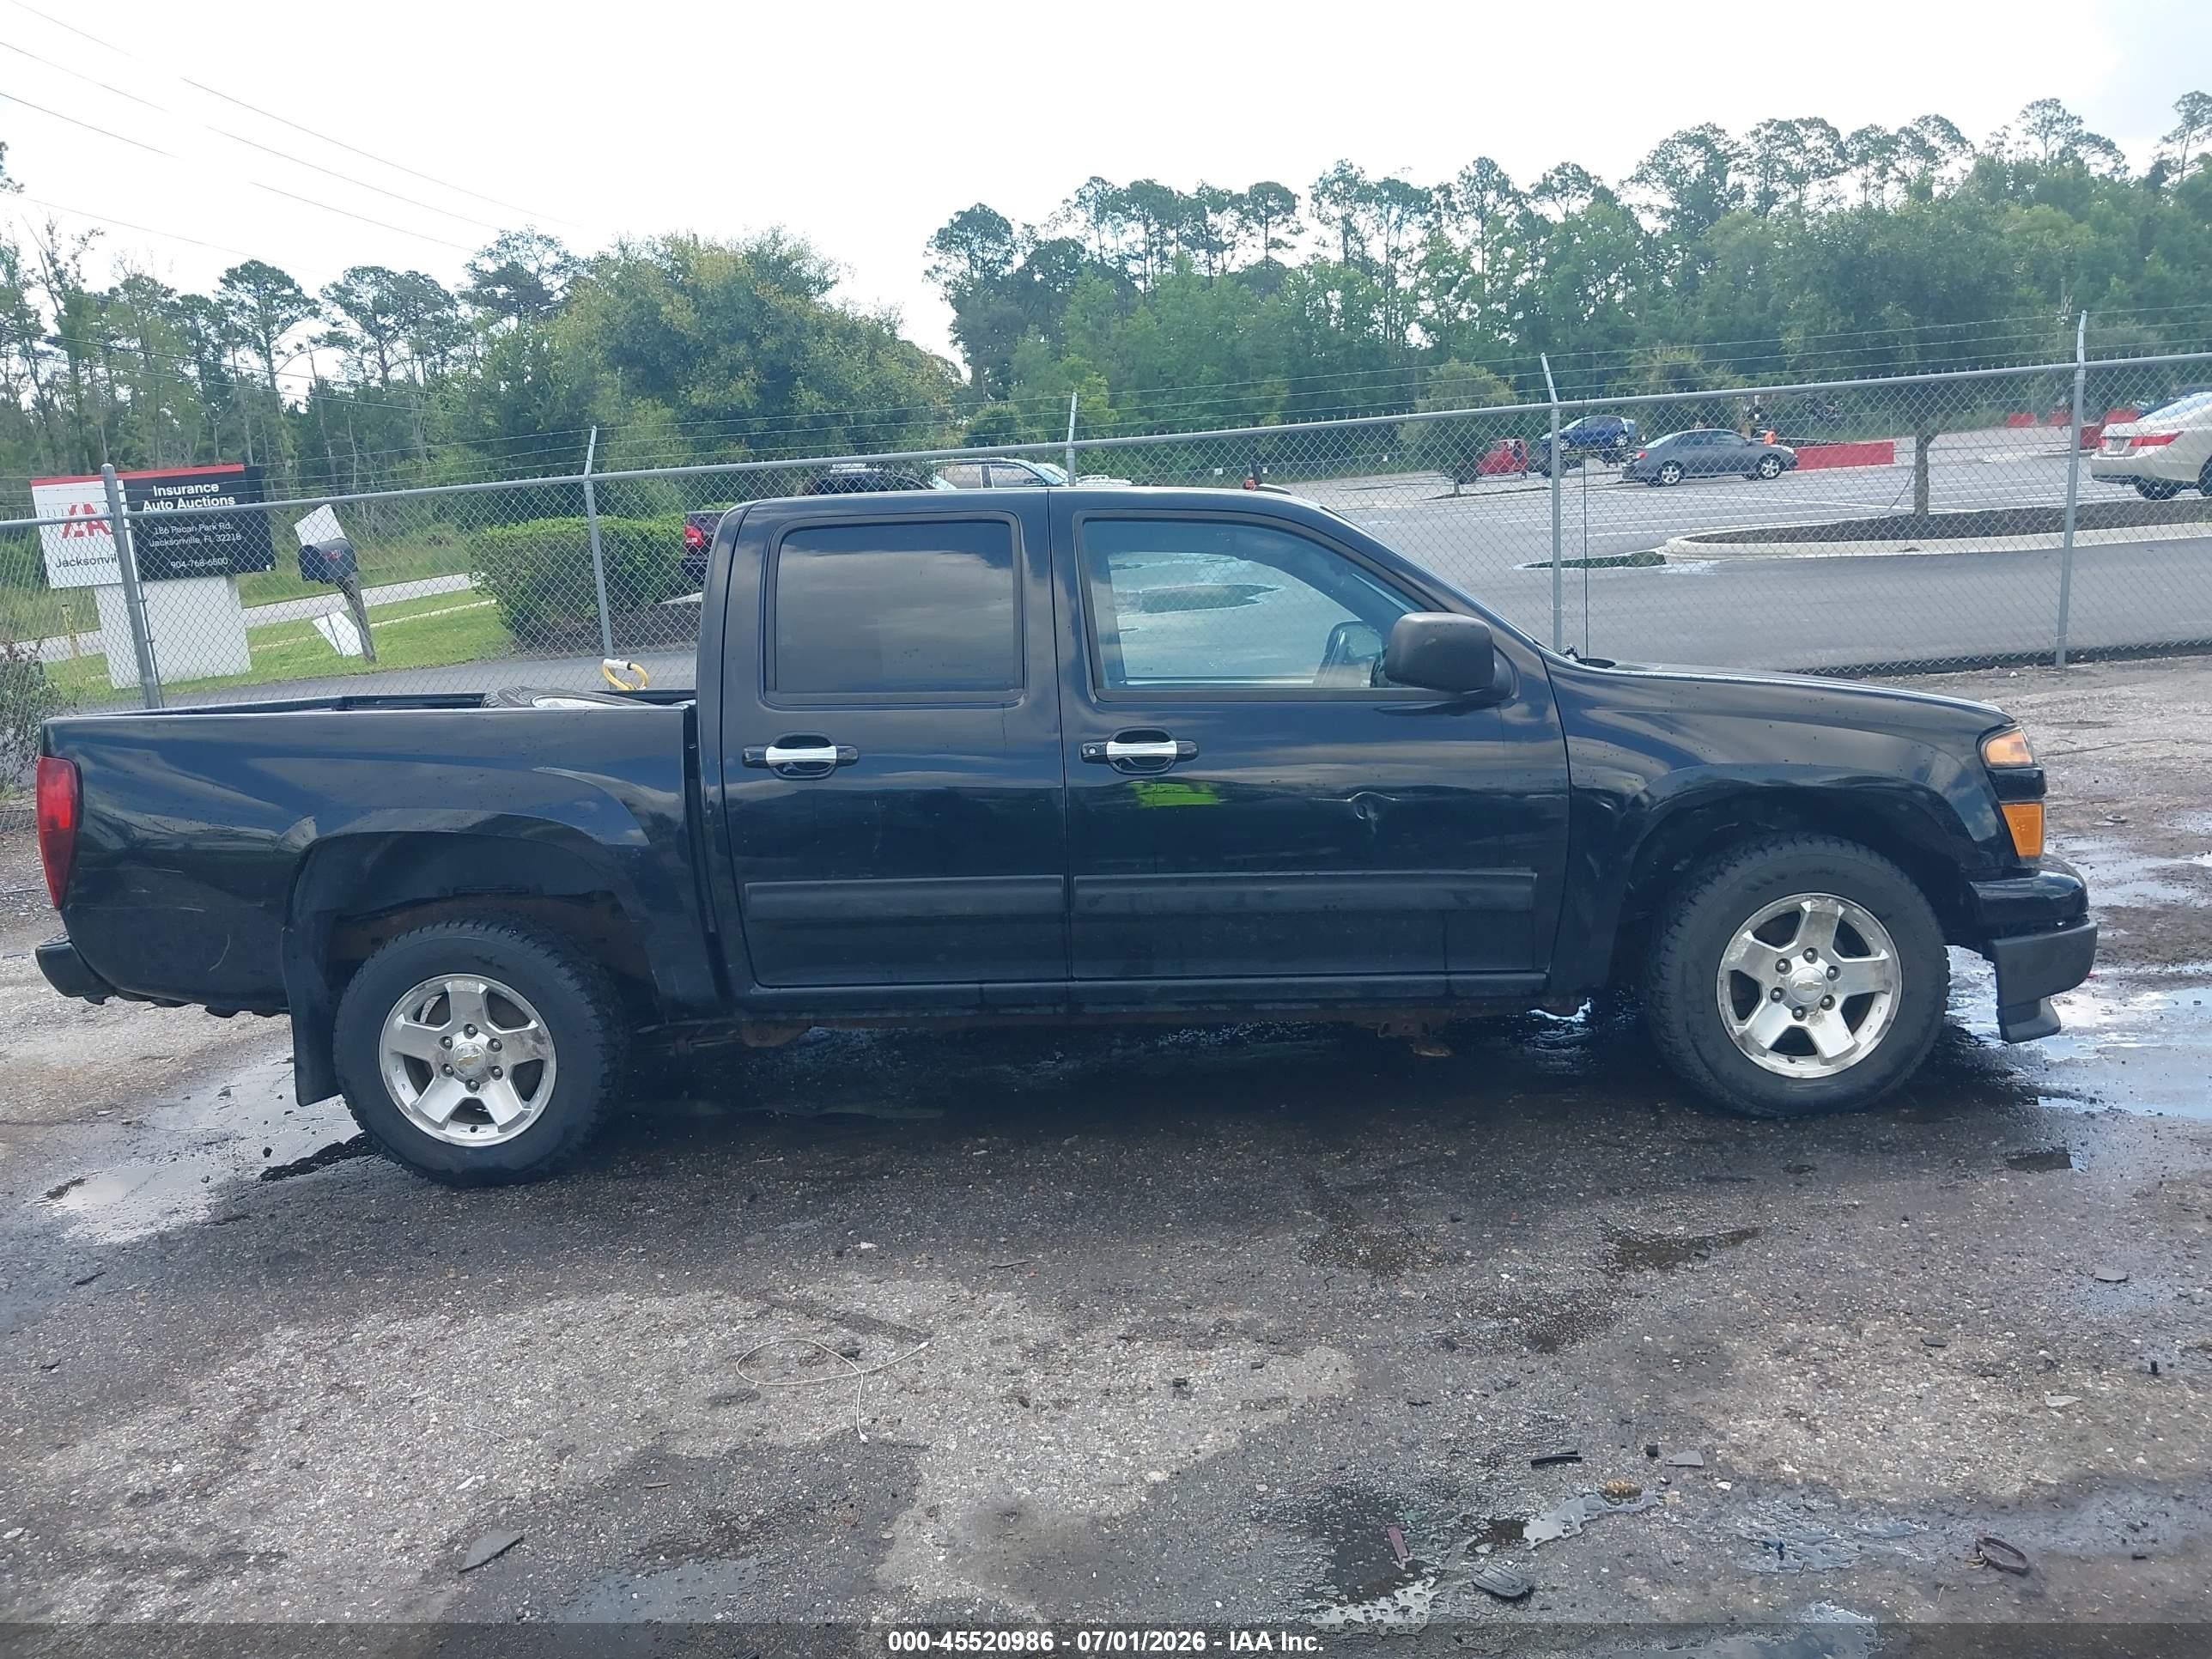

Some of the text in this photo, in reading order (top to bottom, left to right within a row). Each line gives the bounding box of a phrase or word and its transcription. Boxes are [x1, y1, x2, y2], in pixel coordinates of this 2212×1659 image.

[153, 483, 220, 497] Insurance
[143, 495, 235, 513] Auto Auctions
[171, 526, 198, 534] Pecan
[199, 523, 217, 532] Park
[216, 532, 241, 542] 32218
[170, 557, 228, 568] 904-768-6500
